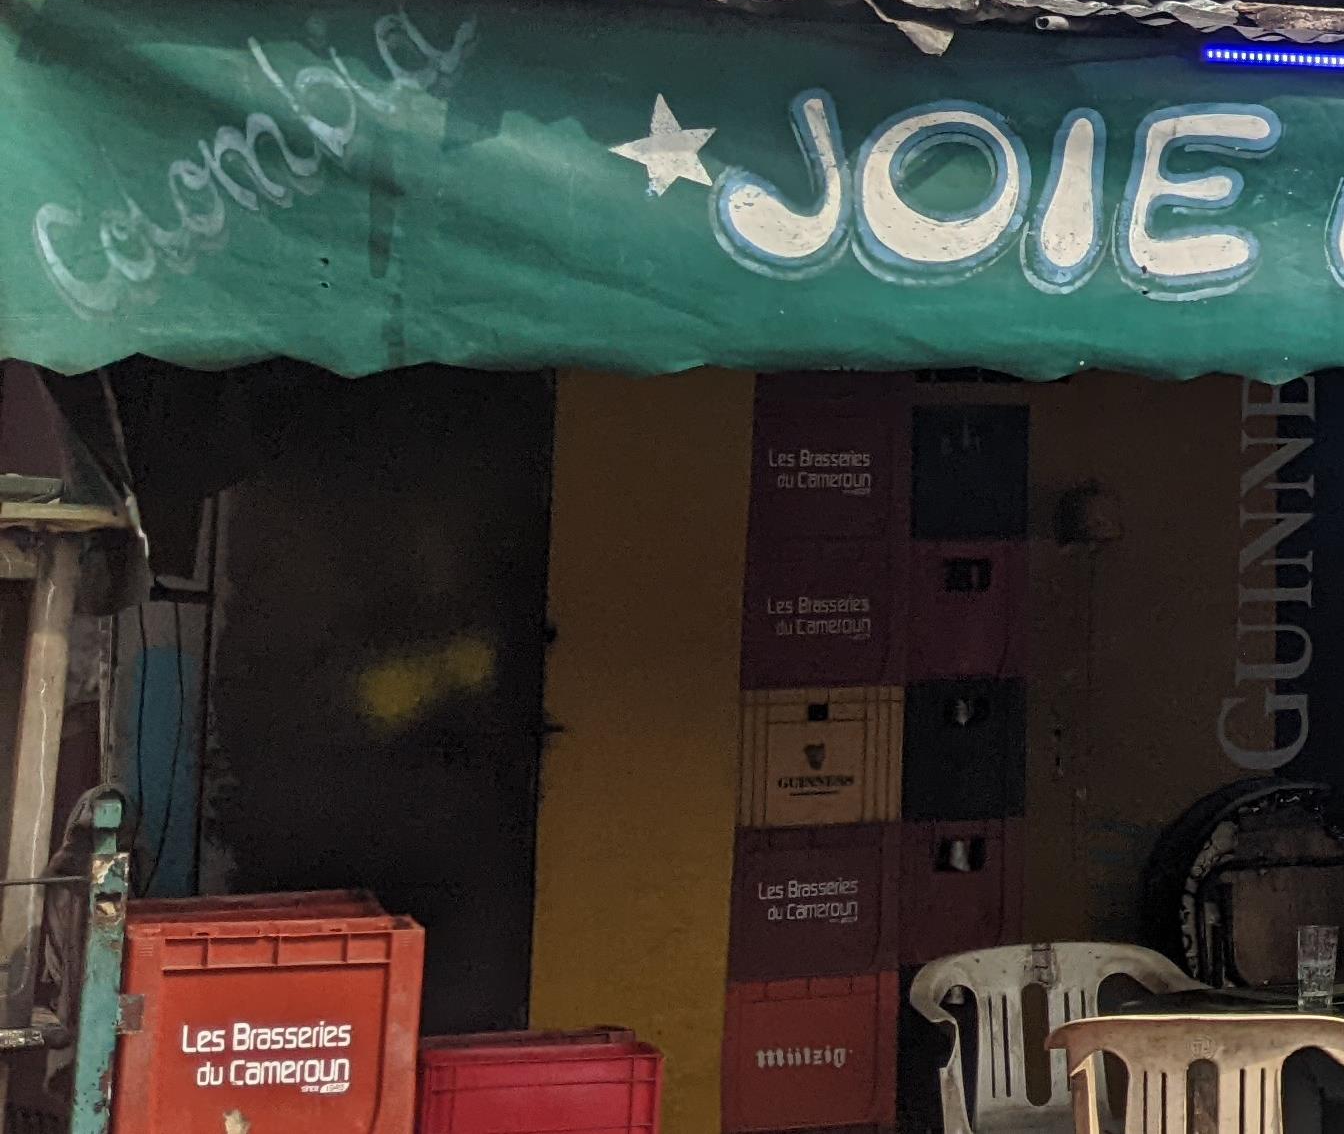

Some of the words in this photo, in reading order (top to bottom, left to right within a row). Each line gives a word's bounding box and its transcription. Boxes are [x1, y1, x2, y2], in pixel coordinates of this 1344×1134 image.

[709, 89, 1282, 302] JOIE
[768, 449, 796, 466] Les
[800, 448, 871, 466] Brasseries
[777, 474, 795, 488] du
[797, 472, 871, 488] Cameroun
[758, 884, 784, 900] Les
[788, 879, 859, 898] Brasseries
[768, 906, 782, 920] du
[787, 902, 858, 919] Cameroun
[181, 1025, 225, 1053] Les
[232, 1021, 351, 1051] Brasseries
[196, 1061, 223, 1086] du
[229, 1058, 350, 1086] Cameroun
